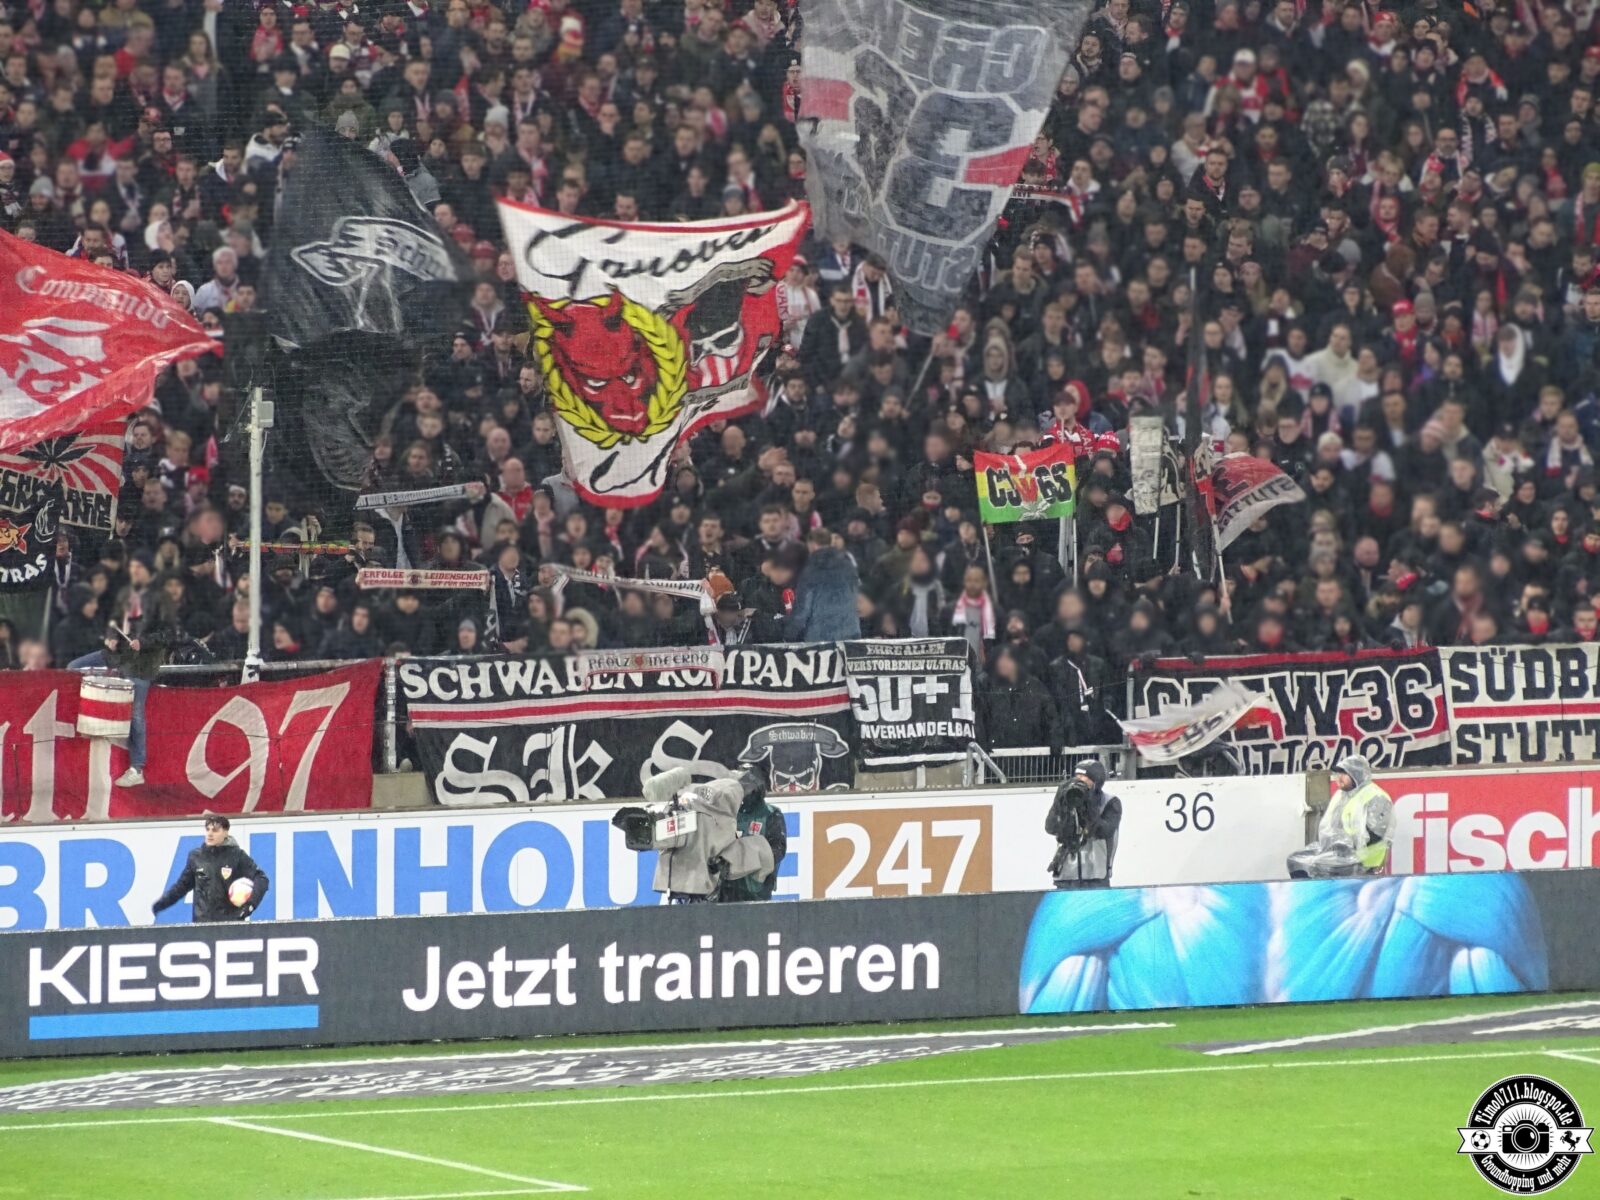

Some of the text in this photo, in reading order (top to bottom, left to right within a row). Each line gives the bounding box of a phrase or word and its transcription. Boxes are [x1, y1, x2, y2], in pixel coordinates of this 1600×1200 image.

[16, 265, 170, 329] Commando
[364, 571, 404, 579] ERFOLGE
[649, 652, 709, 667] INFERNO
[847, 659, 966, 672] VERSTORBENEN ULTRAS
[904, 643, 946, 655] ALLEN
[1450, 646, 1600, 703] SÜDB
[185, 681, 351, 815] 97
[768, 729, 817, 741] Schwaben
[1165, 792, 1215, 833] 36
[825, 822, 981, 900] 247
[29, 936, 319, 1006] KIESER
[402, 932, 939, 1012] Jetzt trainieren
